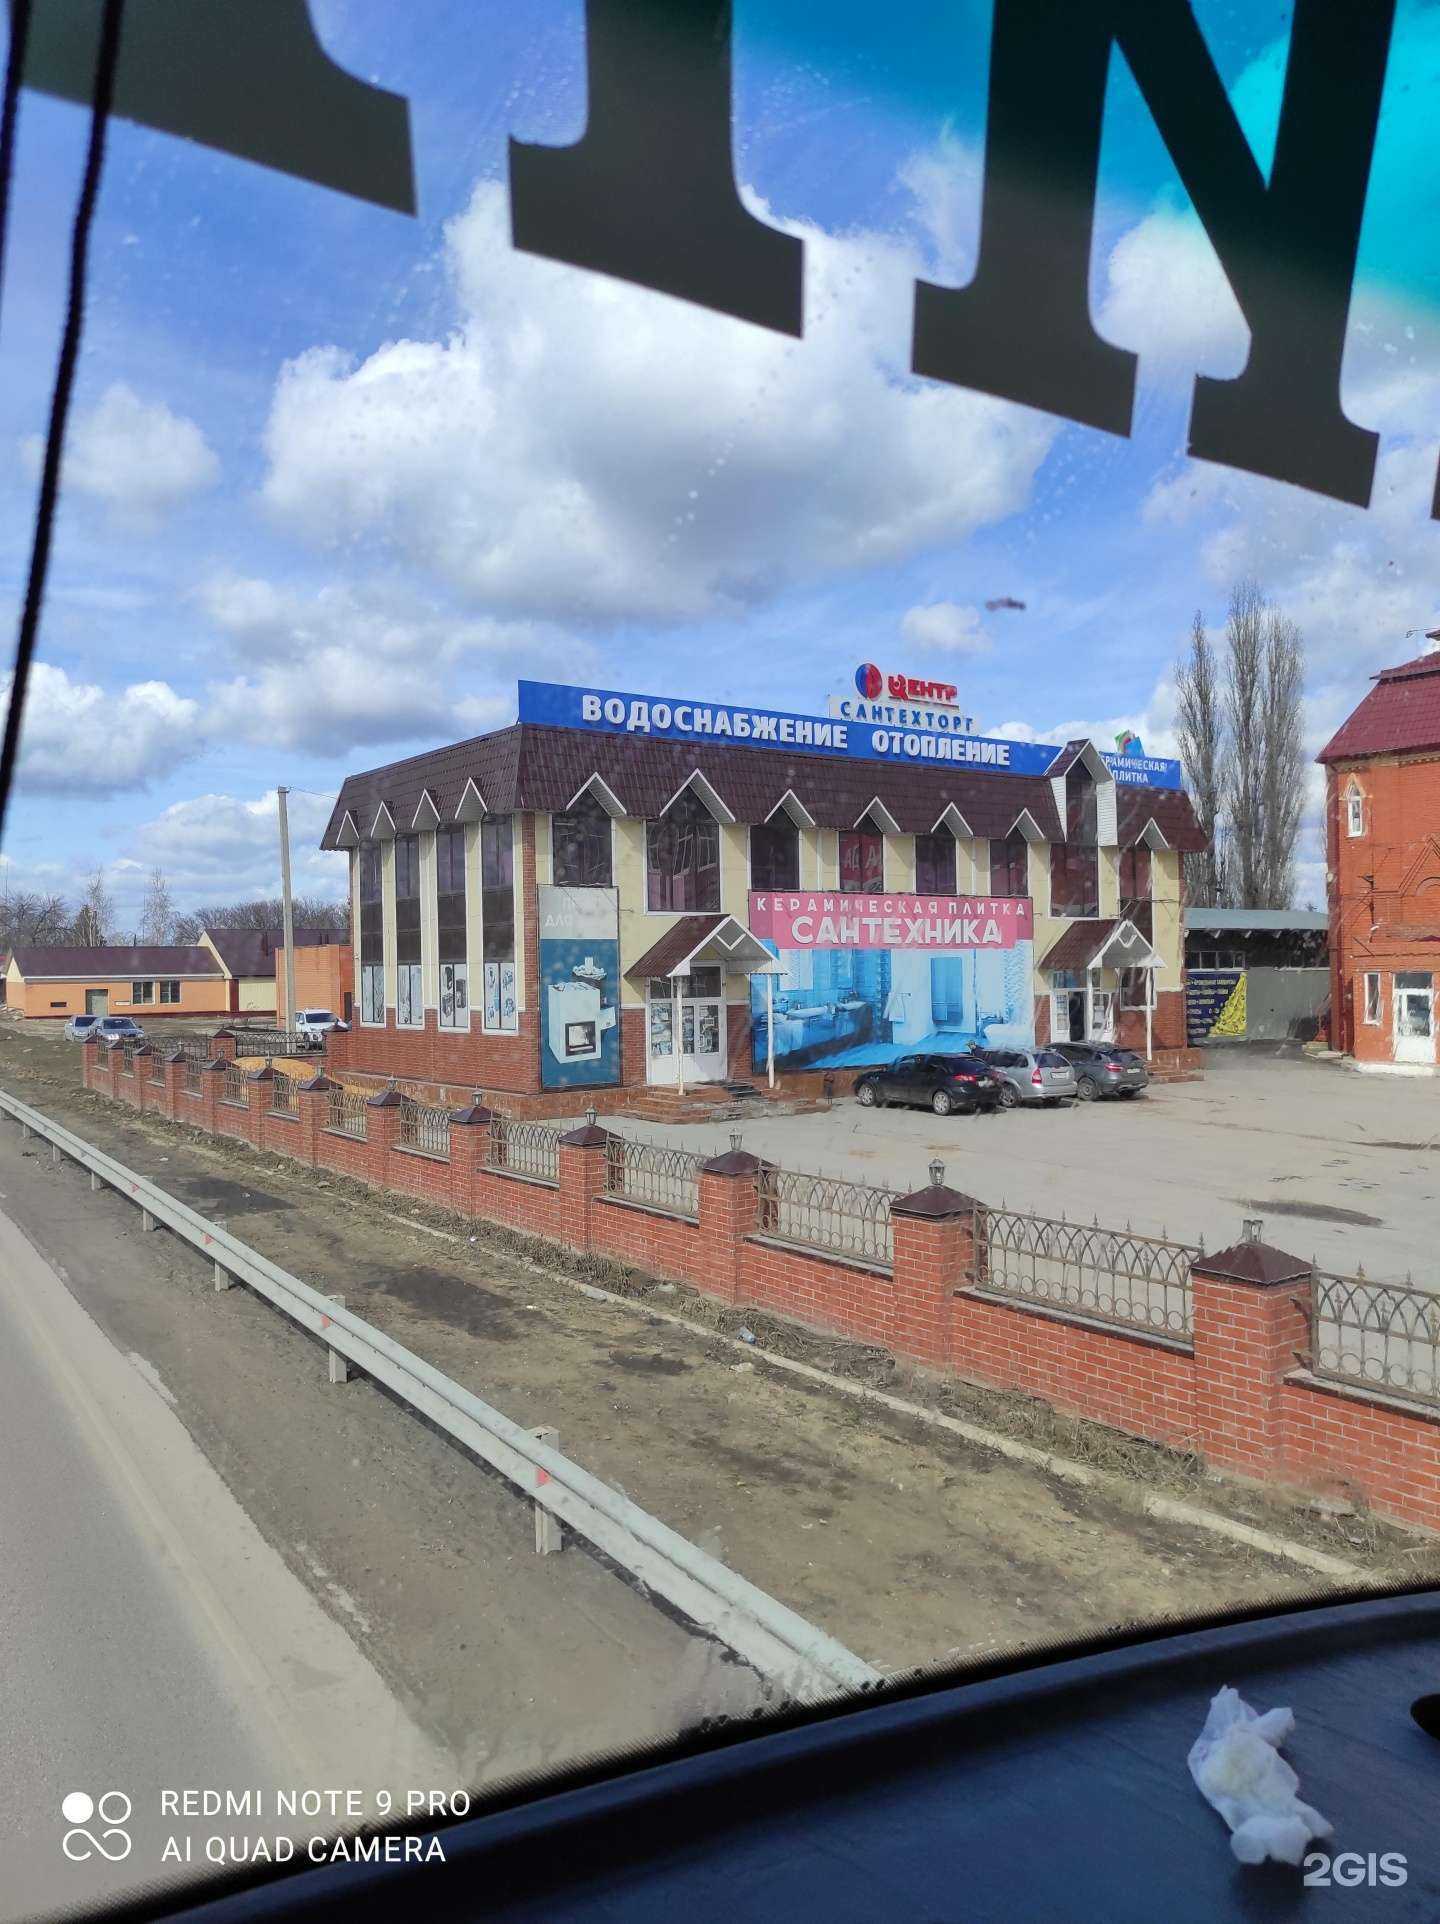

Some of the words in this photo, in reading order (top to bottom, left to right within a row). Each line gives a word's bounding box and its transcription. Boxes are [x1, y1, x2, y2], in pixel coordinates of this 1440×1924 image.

[887, 674, 958, 701] ЦЕНТР
[582, 694, 848, 749] ВОДОСНАБЖЕНИЕ
[872, 729, 1011, 766] ОТОПЛЕНИЕ
[840, 701, 974, 733] САНТЕХТОРГ
[1102, 755, 1168, 773] РАМИЧЕСКАЯ
[1112, 769, 1149, 783] ПЛИТКА
[757, 897, 938, 914] КЕРАМИЧЕСКАЯ
[948, 901, 1025, 916] ПЛИТКА
[791, 916, 1003, 945] САНТЕХНИКА
